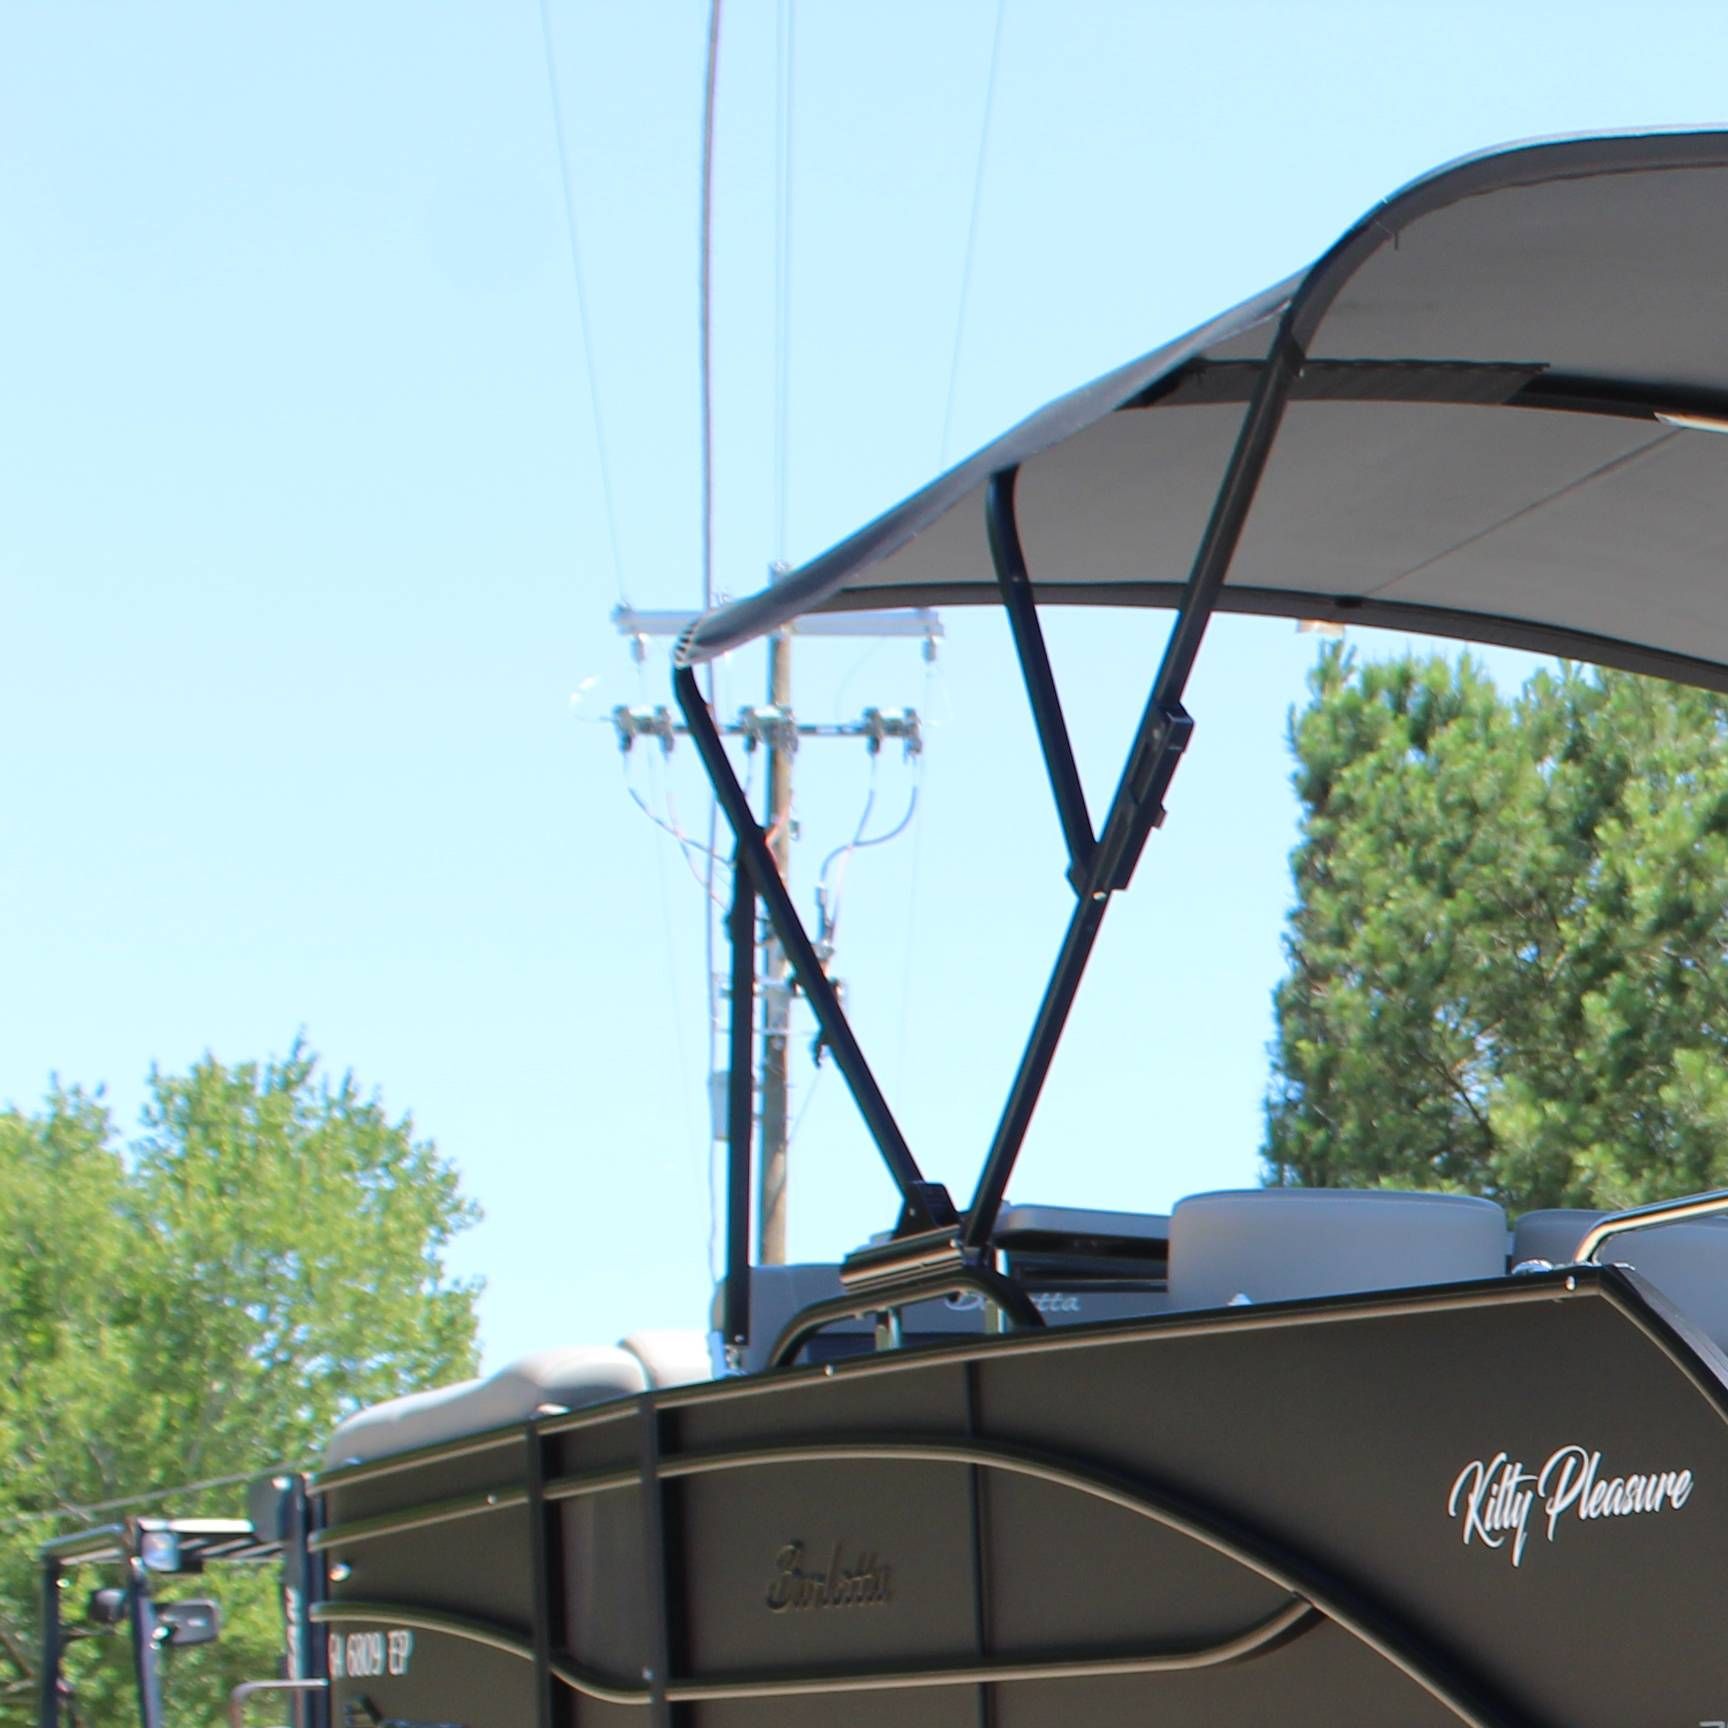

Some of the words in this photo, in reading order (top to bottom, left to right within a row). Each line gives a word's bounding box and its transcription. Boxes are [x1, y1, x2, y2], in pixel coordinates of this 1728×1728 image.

[1448, 1451, 1538, 1567] Kitty
[1537, 1445, 1693, 1541] Pleasure
[387, 1628, 414, 1676] EP
